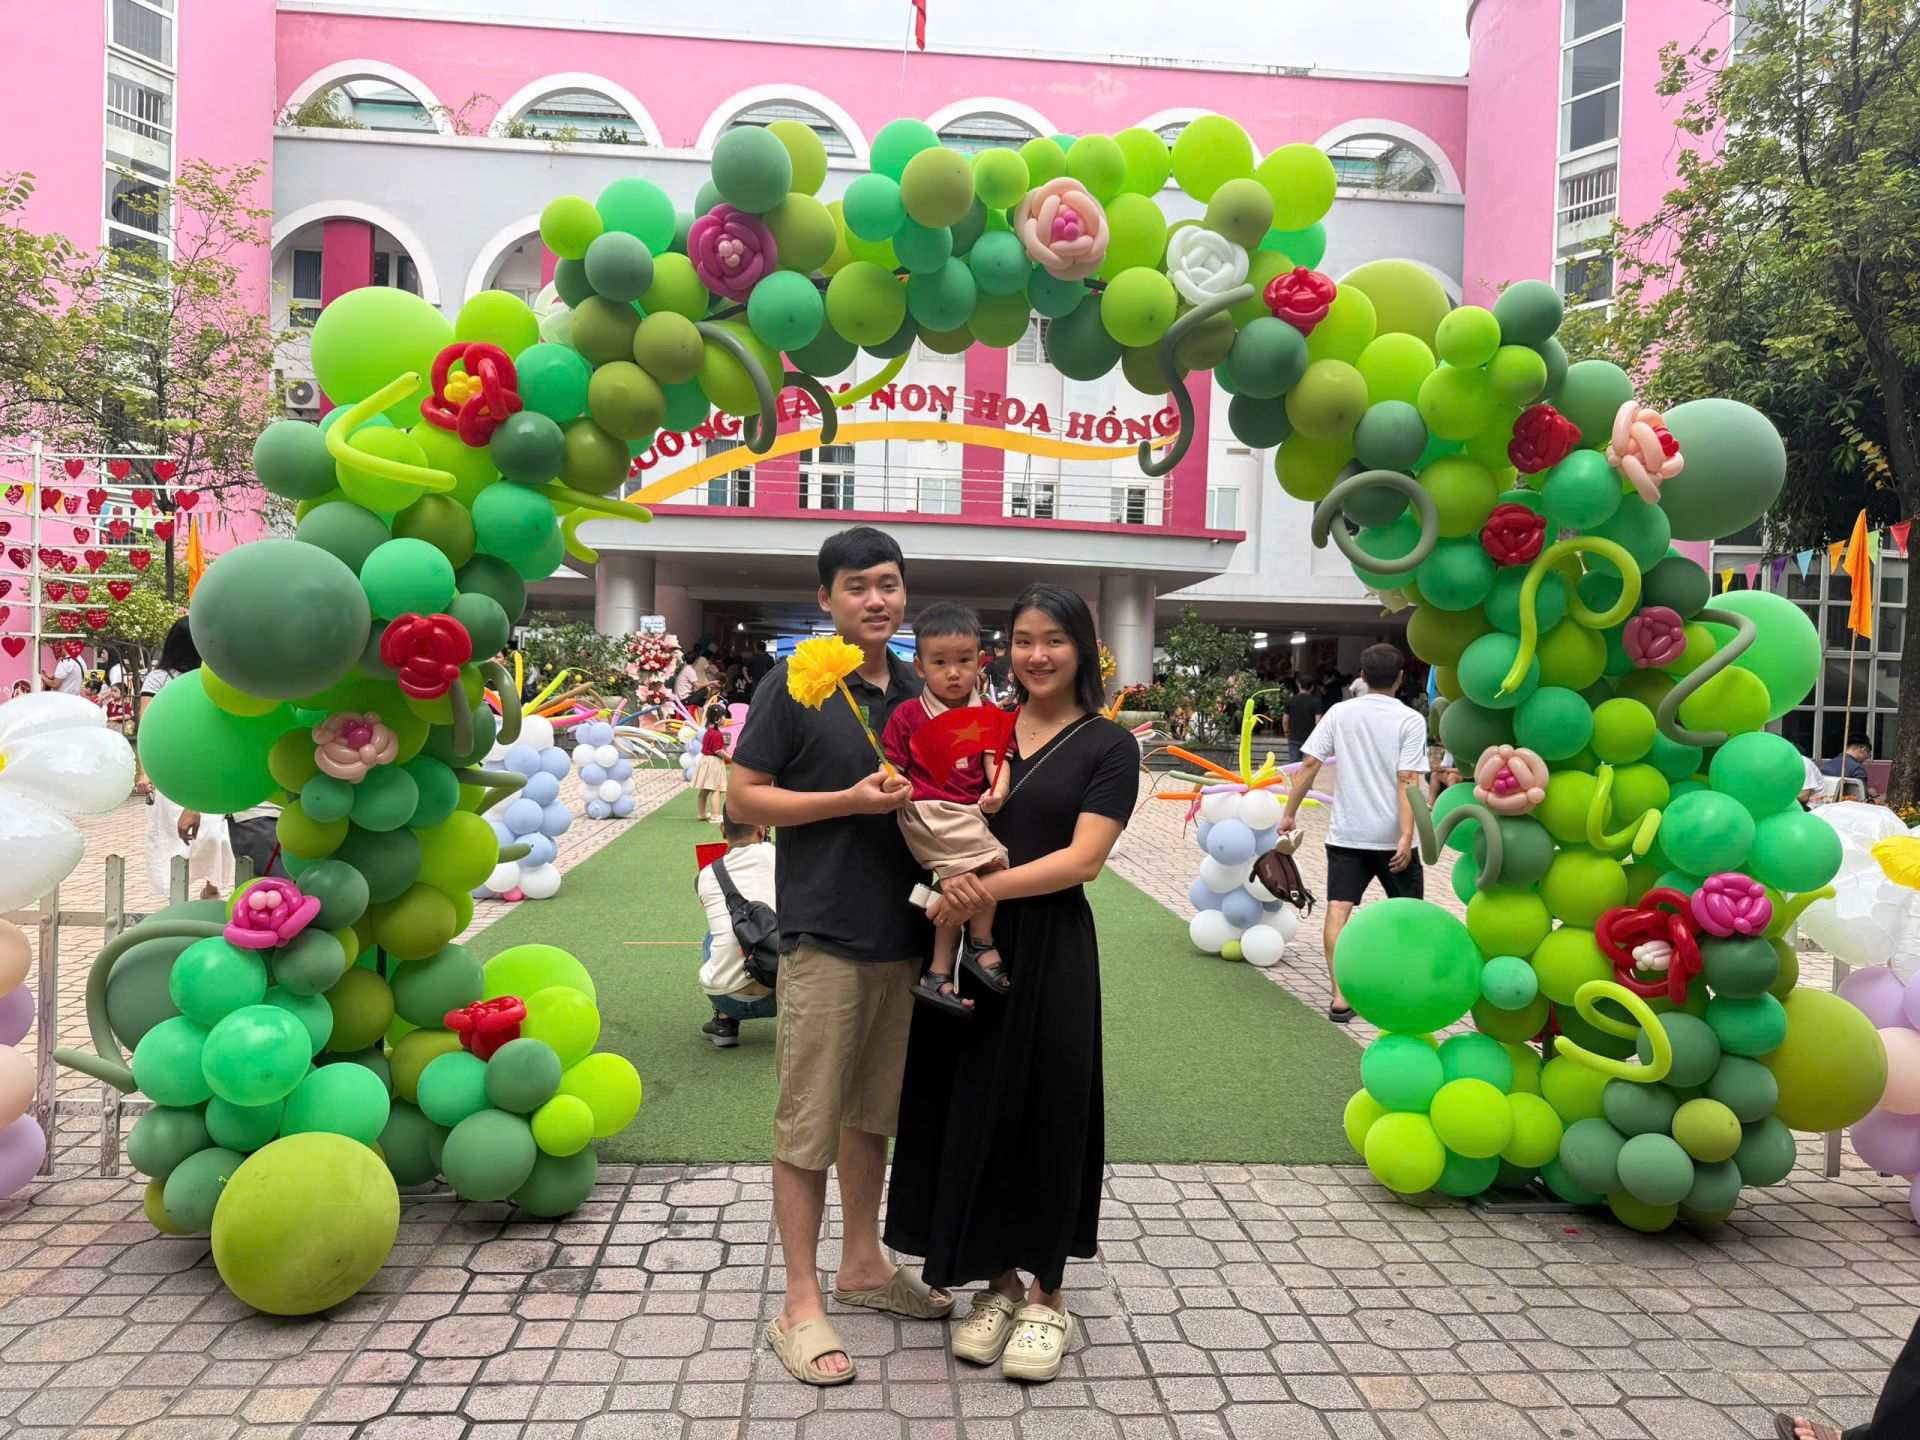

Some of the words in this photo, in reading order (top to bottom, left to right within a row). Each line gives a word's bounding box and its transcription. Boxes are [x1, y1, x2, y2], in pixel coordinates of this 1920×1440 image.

[869, 383, 957, 413] NON
[970, 390, 1051, 432] HOA
[1065, 405, 1181, 444] HỒNG
